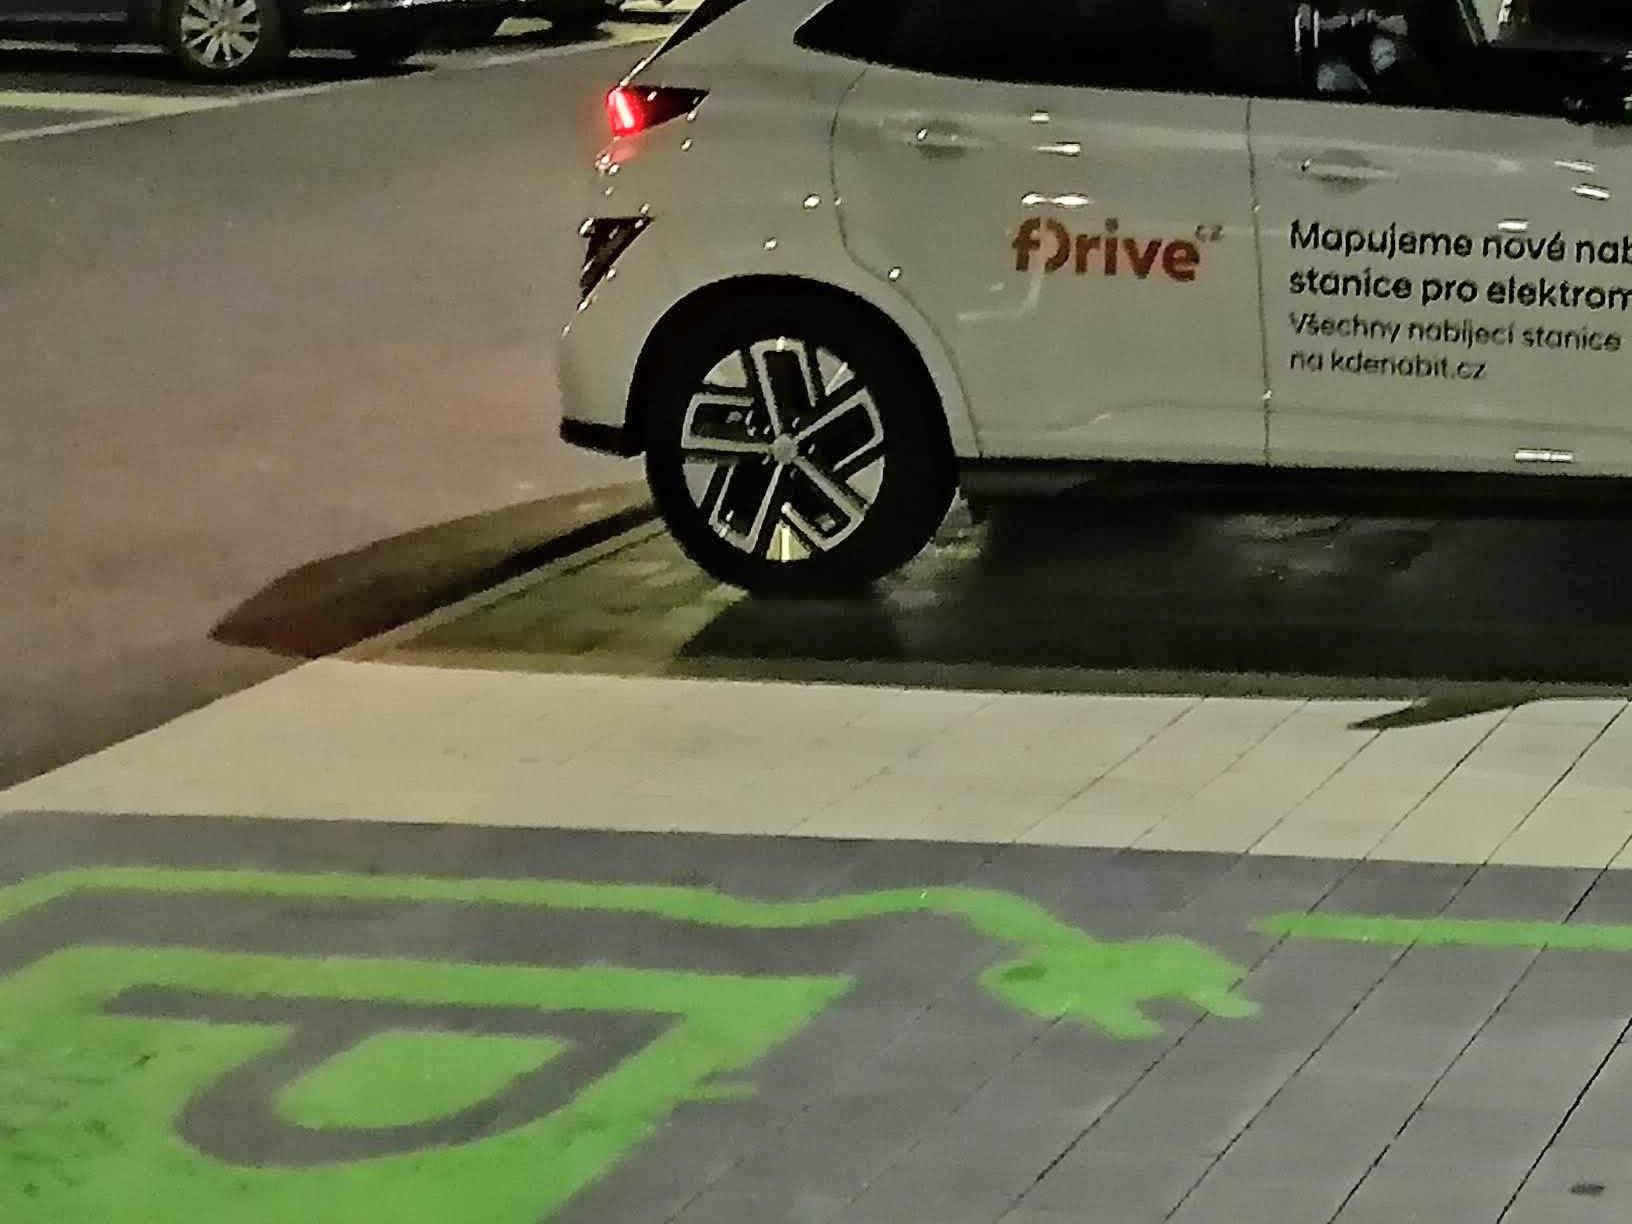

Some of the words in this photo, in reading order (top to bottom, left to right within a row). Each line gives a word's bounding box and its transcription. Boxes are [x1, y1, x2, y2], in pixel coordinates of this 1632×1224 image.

[1012, 217, 1201, 283] fDrive
[1290, 219, 1473, 260] Mapujeme
[1482, 231, 1567, 264] nové
[1289, 267, 1413, 299] stanice
[1421, 278, 1479, 307] pro
[1289, 311, 1402, 344] Všechny
[1522, 322, 1622, 352] stanice
[1290, 349, 1324, 372] na
[1330, 345, 1487, 380] kdenabit.cz
